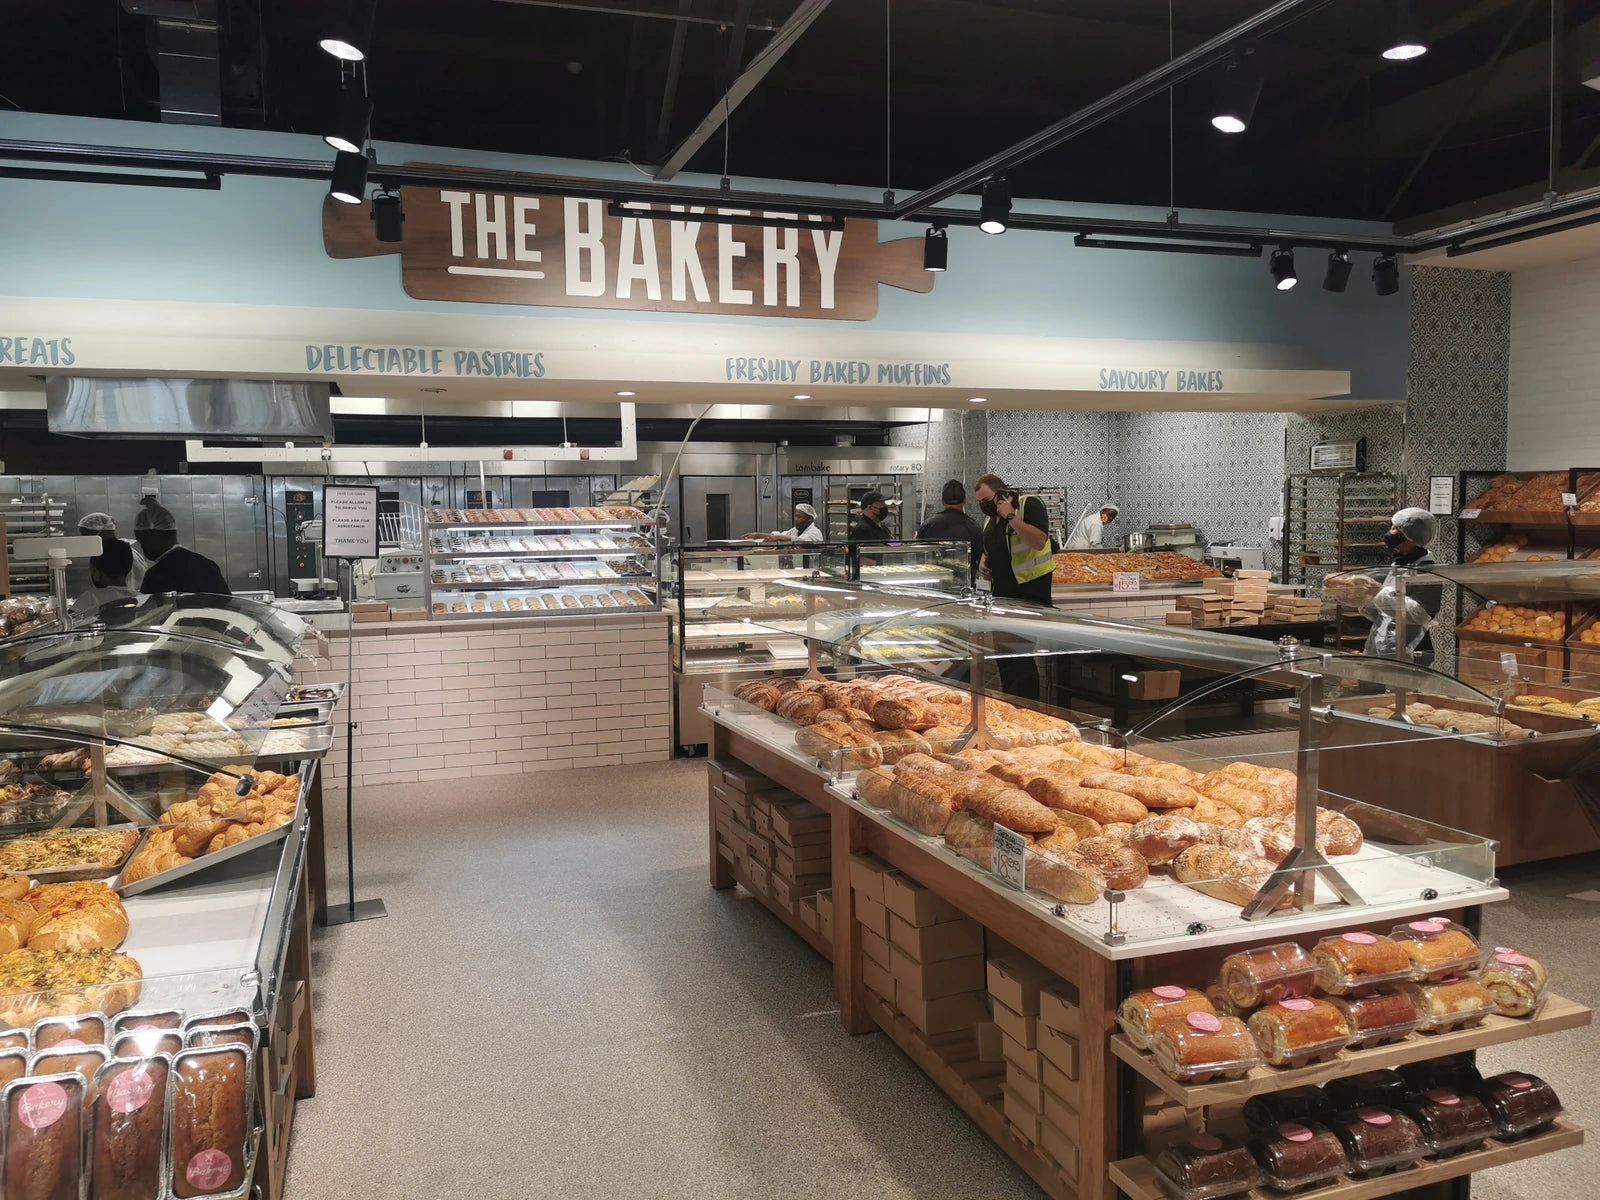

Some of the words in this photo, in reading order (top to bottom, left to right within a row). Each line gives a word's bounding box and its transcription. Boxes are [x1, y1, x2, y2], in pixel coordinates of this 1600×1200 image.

[440, 190, 542, 262] THE
[563, 196, 844, 309] BAKERY
[304, 344, 444, 375] DELECTABLE
[453, 350, 546, 378] PASTRIES
[725, 357, 801, 382] FRESHLY
[810, 360, 870, 384] BAKED
[877, 363, 951, 386] MUFFINS
[1098, 368, 1170, 391] SAVOURY
[1176, 370, 1224, 391] BAKES
[795, 461, 831, 473] tombake
[889, 464, 909, 473] rotary
[910, 462, 922, 472] 80
